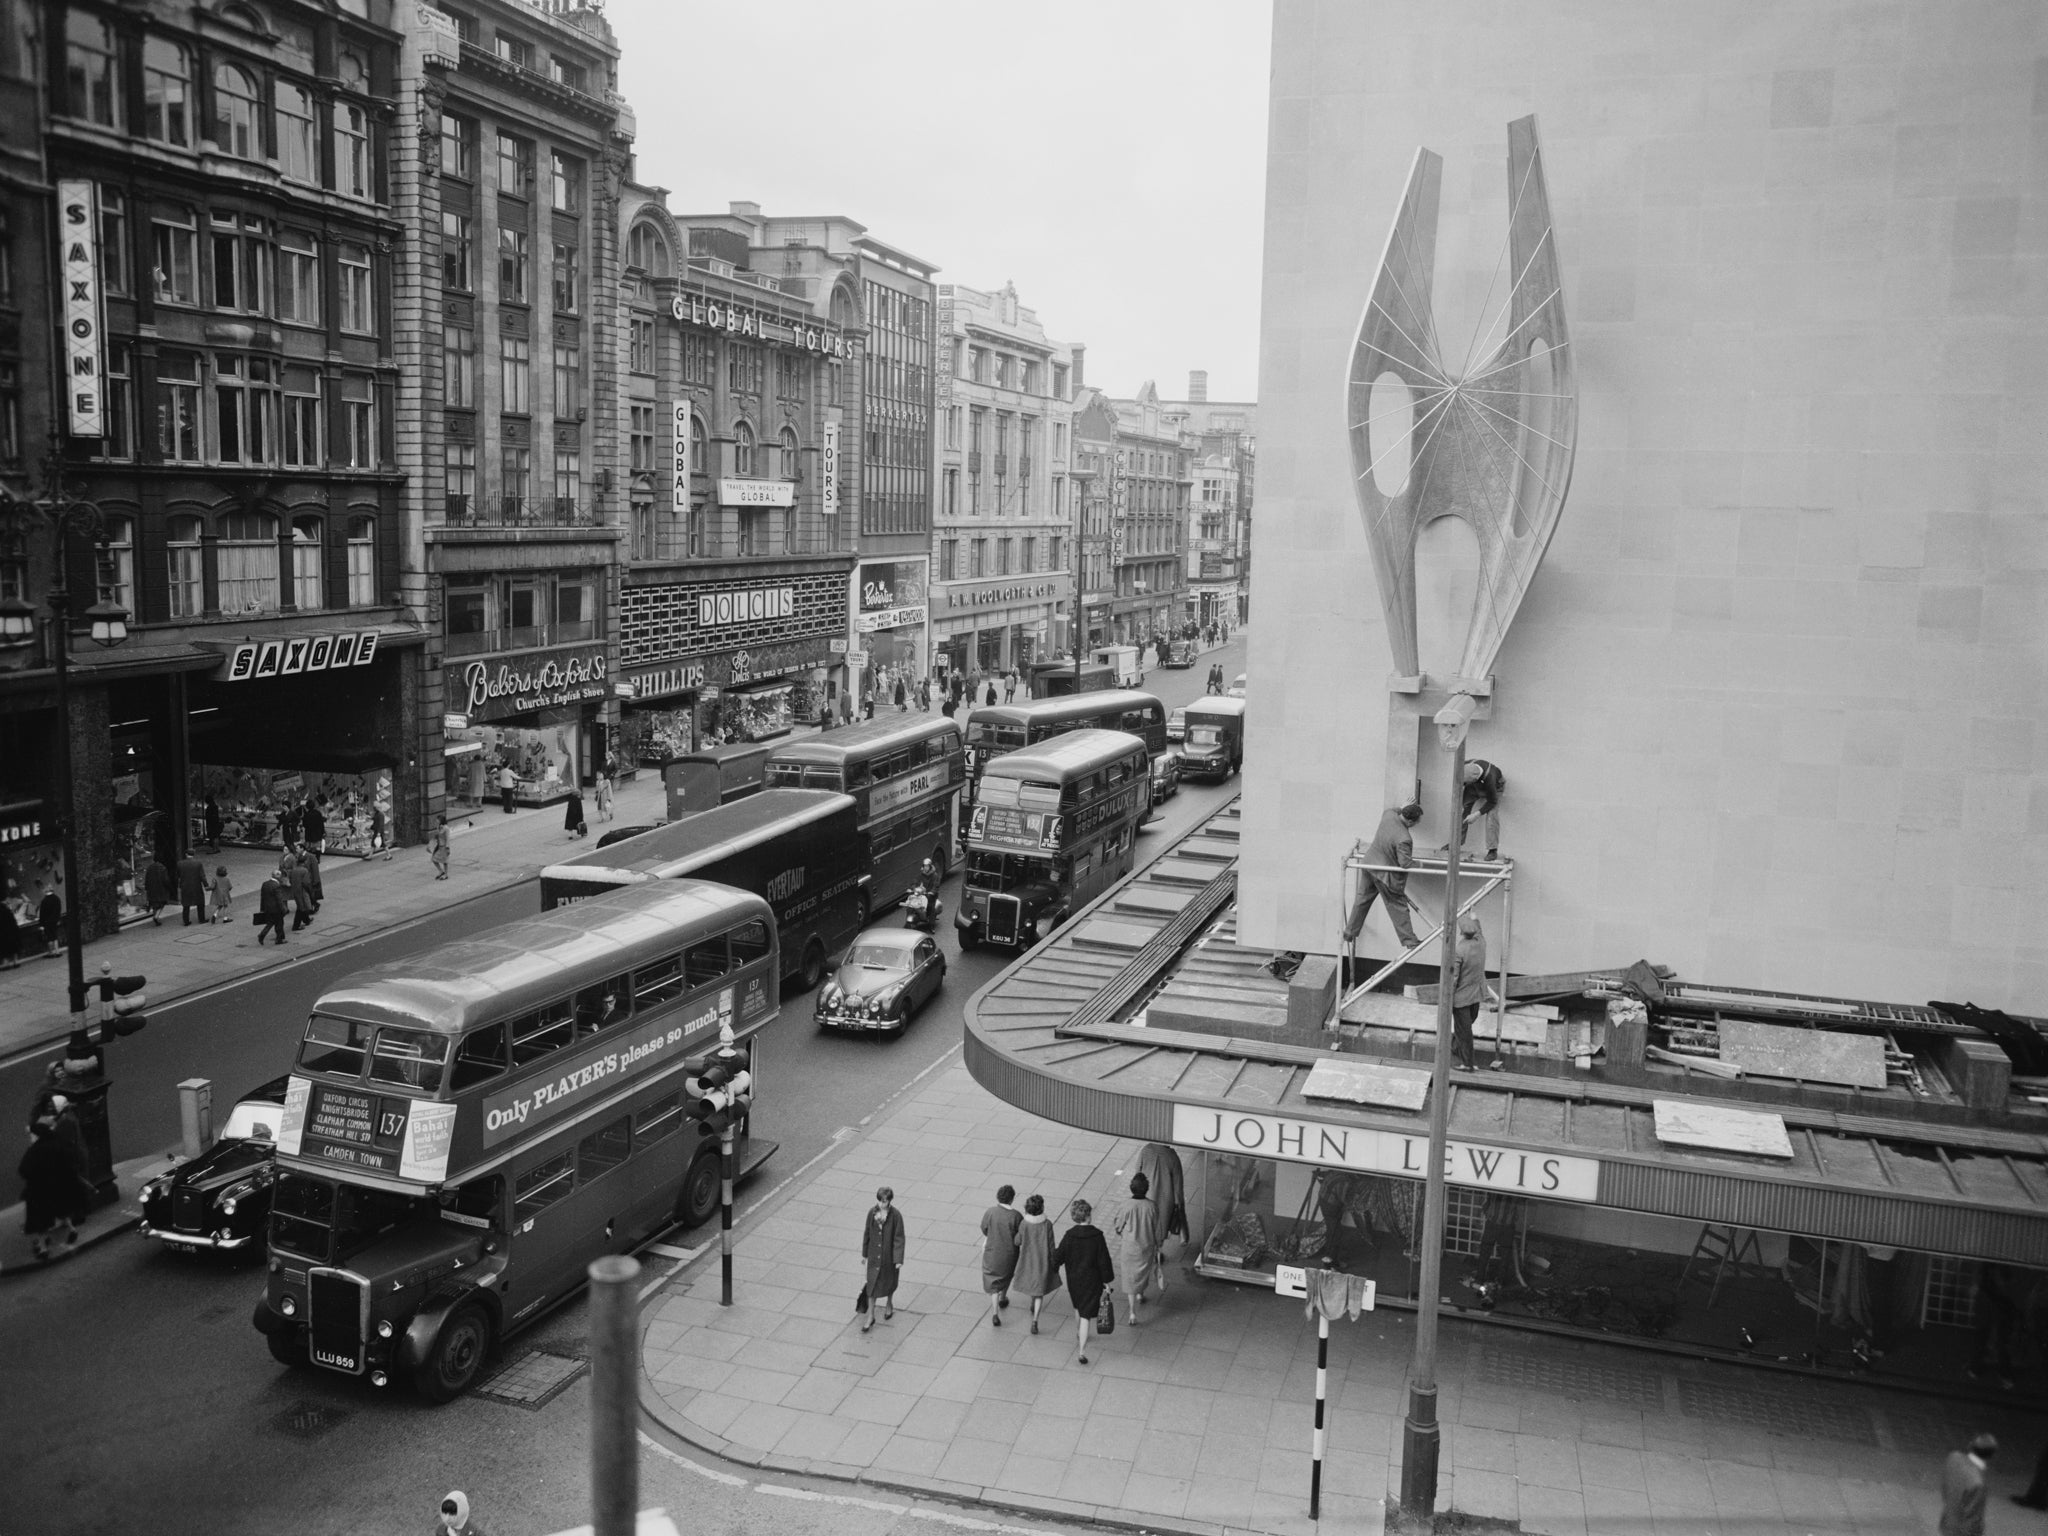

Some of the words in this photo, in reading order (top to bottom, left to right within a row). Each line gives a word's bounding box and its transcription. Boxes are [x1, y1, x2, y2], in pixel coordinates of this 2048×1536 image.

[66, 204, 95, 414] SAXONE
[672, 297, 767, 339] GLOBAL
[793, 326, 853, 359] TOURS
[865, 403, 928, 424] BERKERTEX
[675, 407, 685, 505] GLOBAL
[825, 433, 833, 501] TOURS
[741, 492, 775, 502] GLOBAL
[1115, 453, 1126, 518] CECIL
[1113, 528, 1123, 566] GEE
[703, 590, 790, 623] DOLCIS
[972, 586, 1026, 606] WOOLWORTH
[233, 635, 376, 677] SAXONE
[465, 660, 532, 716] Babers
[542, 658, 592, 692] Oxford
[593, 655, 606, 681] St
[629, 665, 705, 697] PHILLIPS
[731, 669, 750, 685] Dolcis
[516, 695, 550, 711] Church's
[553, 690, 581, 706] English
[583, 687, 605, 699] Shoes
[910, 776, 929, 795] PEARL
[1098, 790, 1130, 822] DULUX
[1, 822, 40, 843] XONE
[767, 866, 805, 903] EVERTAUT
[784, 896, 817, 920] OFFICE
[821, 875, 857, 901] SEATING
[749, 978, 760, 992] 137
[486, 1098, 531, 1130] Only
[533, 1052, 618, 1110] PLAYER'S
[619, 1035, 664, 1072] please
[667, 1028, 682, 1045] so
[684, 1007, 718, 1036] much
[321, 1104, 370, 1119] KNIGHTSBRIDGE
[323, 1092, 347, 1104] OXFORD
[348, 1095, 369, 1109] CIRCUS
[311, 1124, 344, 1139] STREATHAM
[346, 1129, 358, 1140] HILL
[316, 1114, 345, 1128] CLAPHAM
[347, 1118, 372, 1131] COMMON
[379, 1112, 406, 1136] 137
[323, 1145, 356, 1162] CAMDEN
[360, 1152, 383, 1168] TOWN
[1203, 1113, 1348, 1162] JOHN
[1402, 1137, 1560, 1192] LEWIS
[1283, 1271, 1303, 1282] ONE
[317, 1349, 335, 1363] LLU
[336, 1355, 354, 1369] 859
